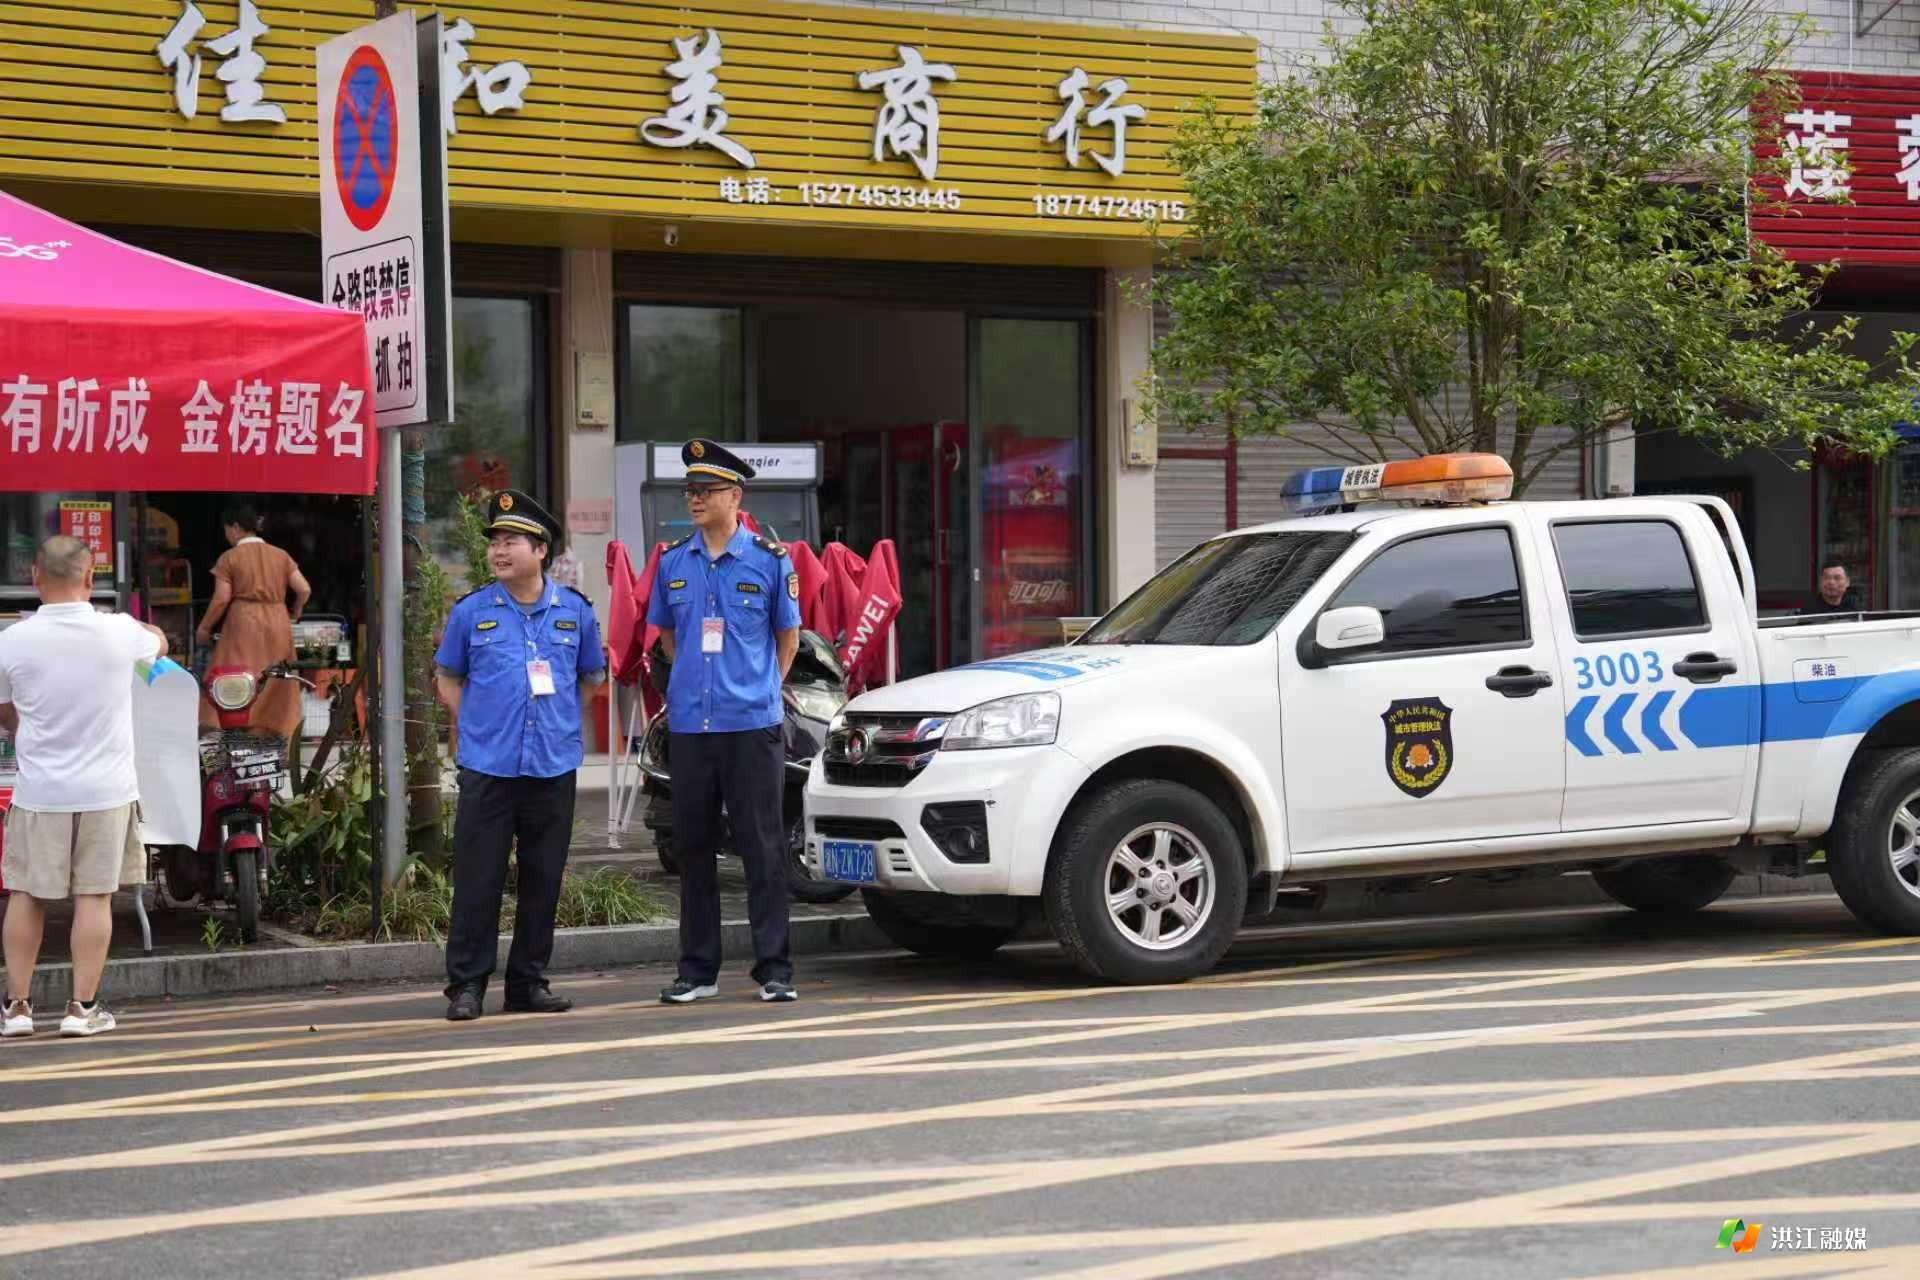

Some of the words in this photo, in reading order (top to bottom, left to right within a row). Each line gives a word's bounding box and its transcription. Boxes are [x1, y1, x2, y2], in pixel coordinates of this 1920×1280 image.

[798, 182, 962, 211] 15274533445
[1032, 193, 1186, 221] 18774724515
[332, 256, 411, 322] 全路段禁停
[0, 374, 151, 456] 有所成
[179, 378, 366, 459] 金榜题名
[1573, 650, 1664, 690] 3003
[1811, 662, 1837, 677] 柴油
[1388, 704, 1447, 723] 中华人民共和国
[1394, 720, 1442, 734] 城市管理执法
